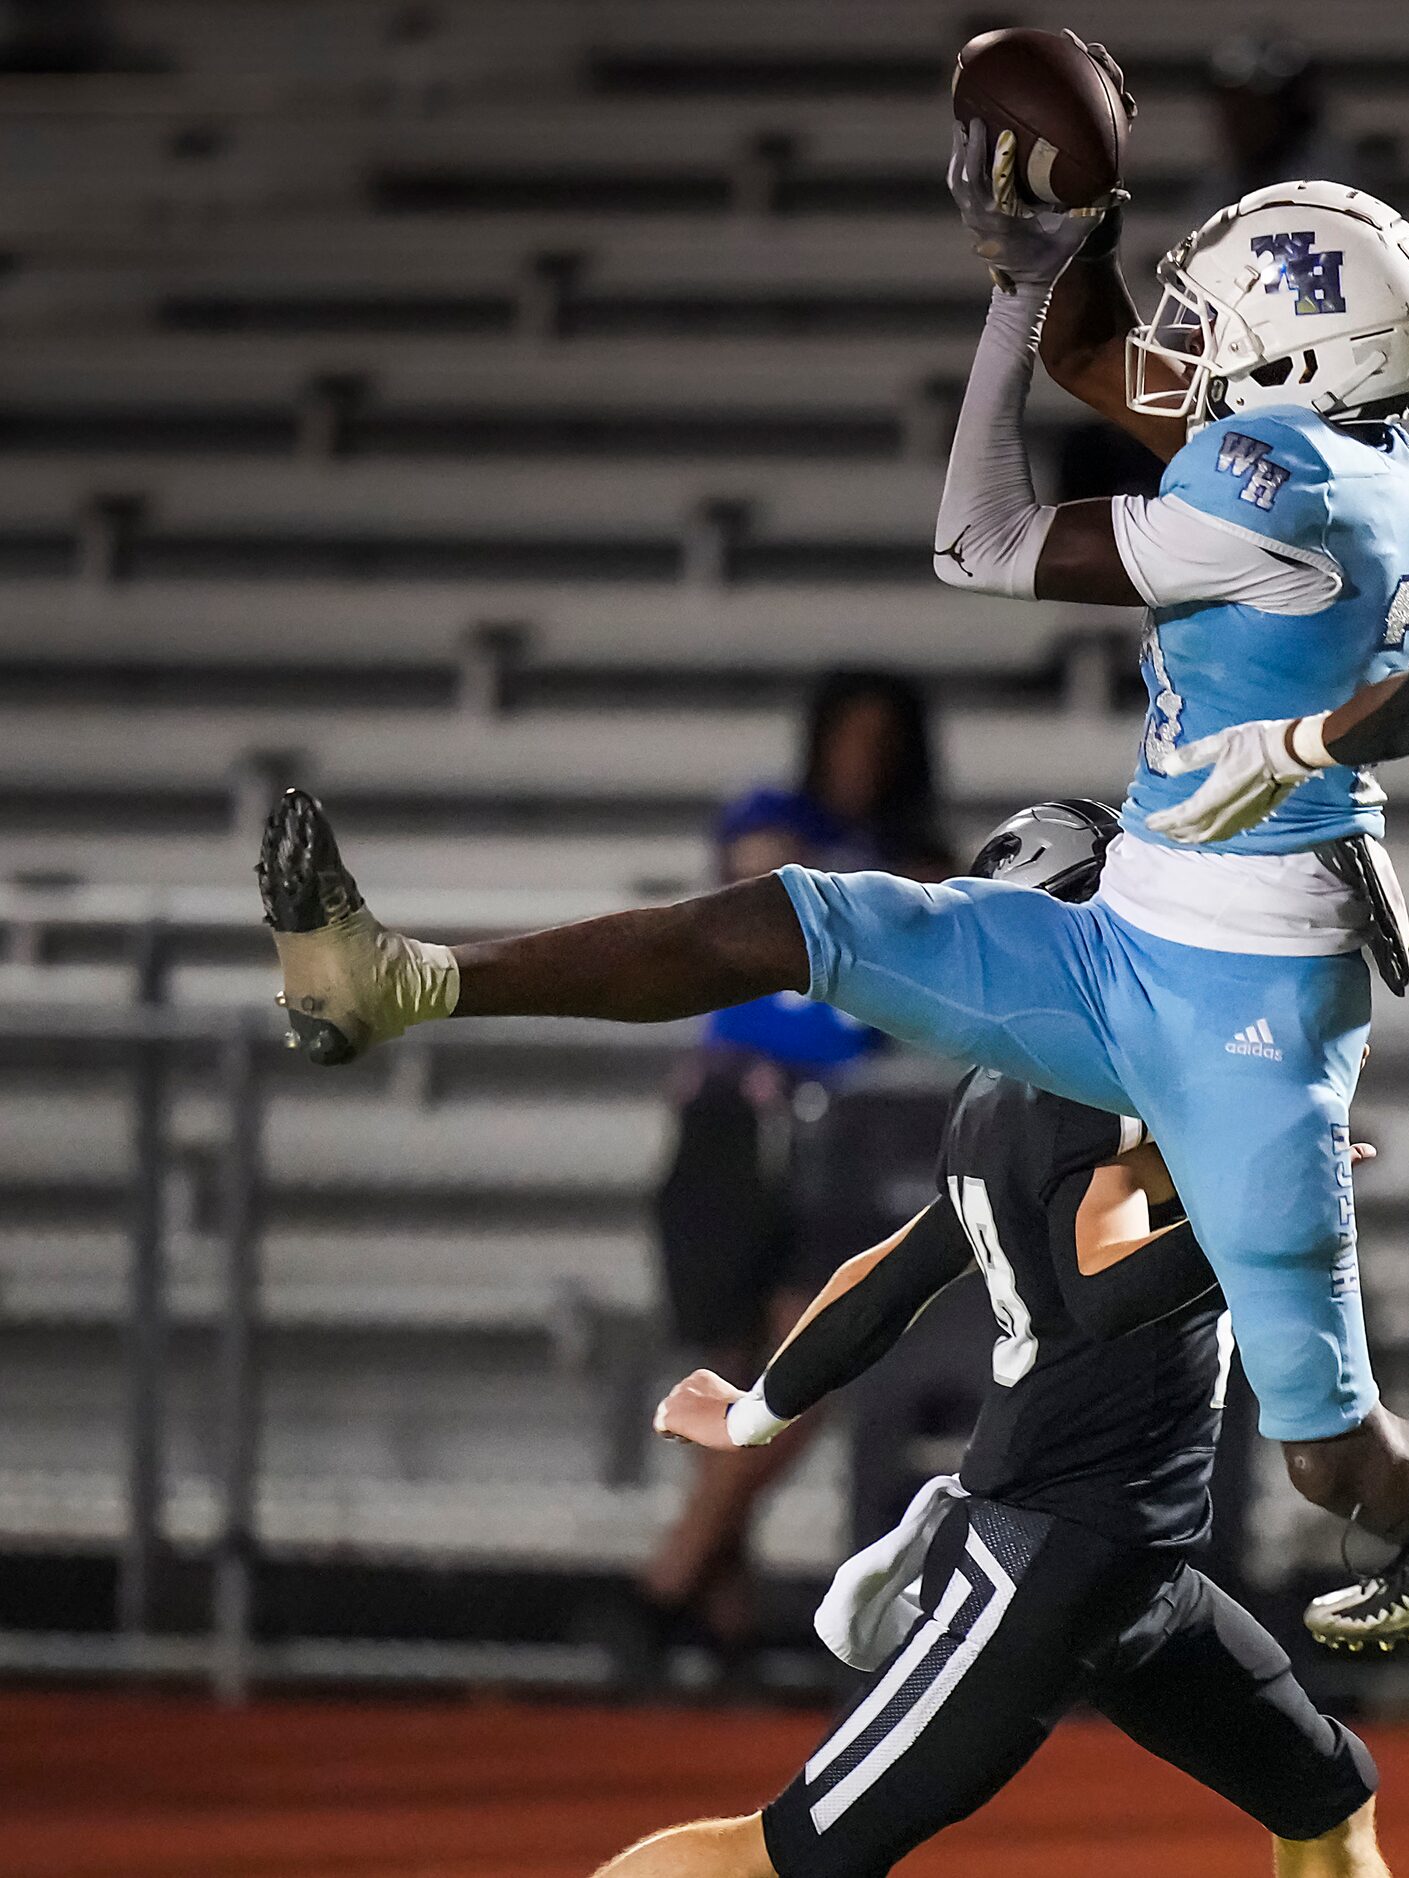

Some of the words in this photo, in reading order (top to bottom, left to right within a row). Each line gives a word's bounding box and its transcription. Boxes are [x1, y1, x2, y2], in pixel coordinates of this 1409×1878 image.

[1250, 231, 1347, 316] WH
[1215, 431, 1292, 512] WH
[1224, 1041, 1283, 1063] adidas
